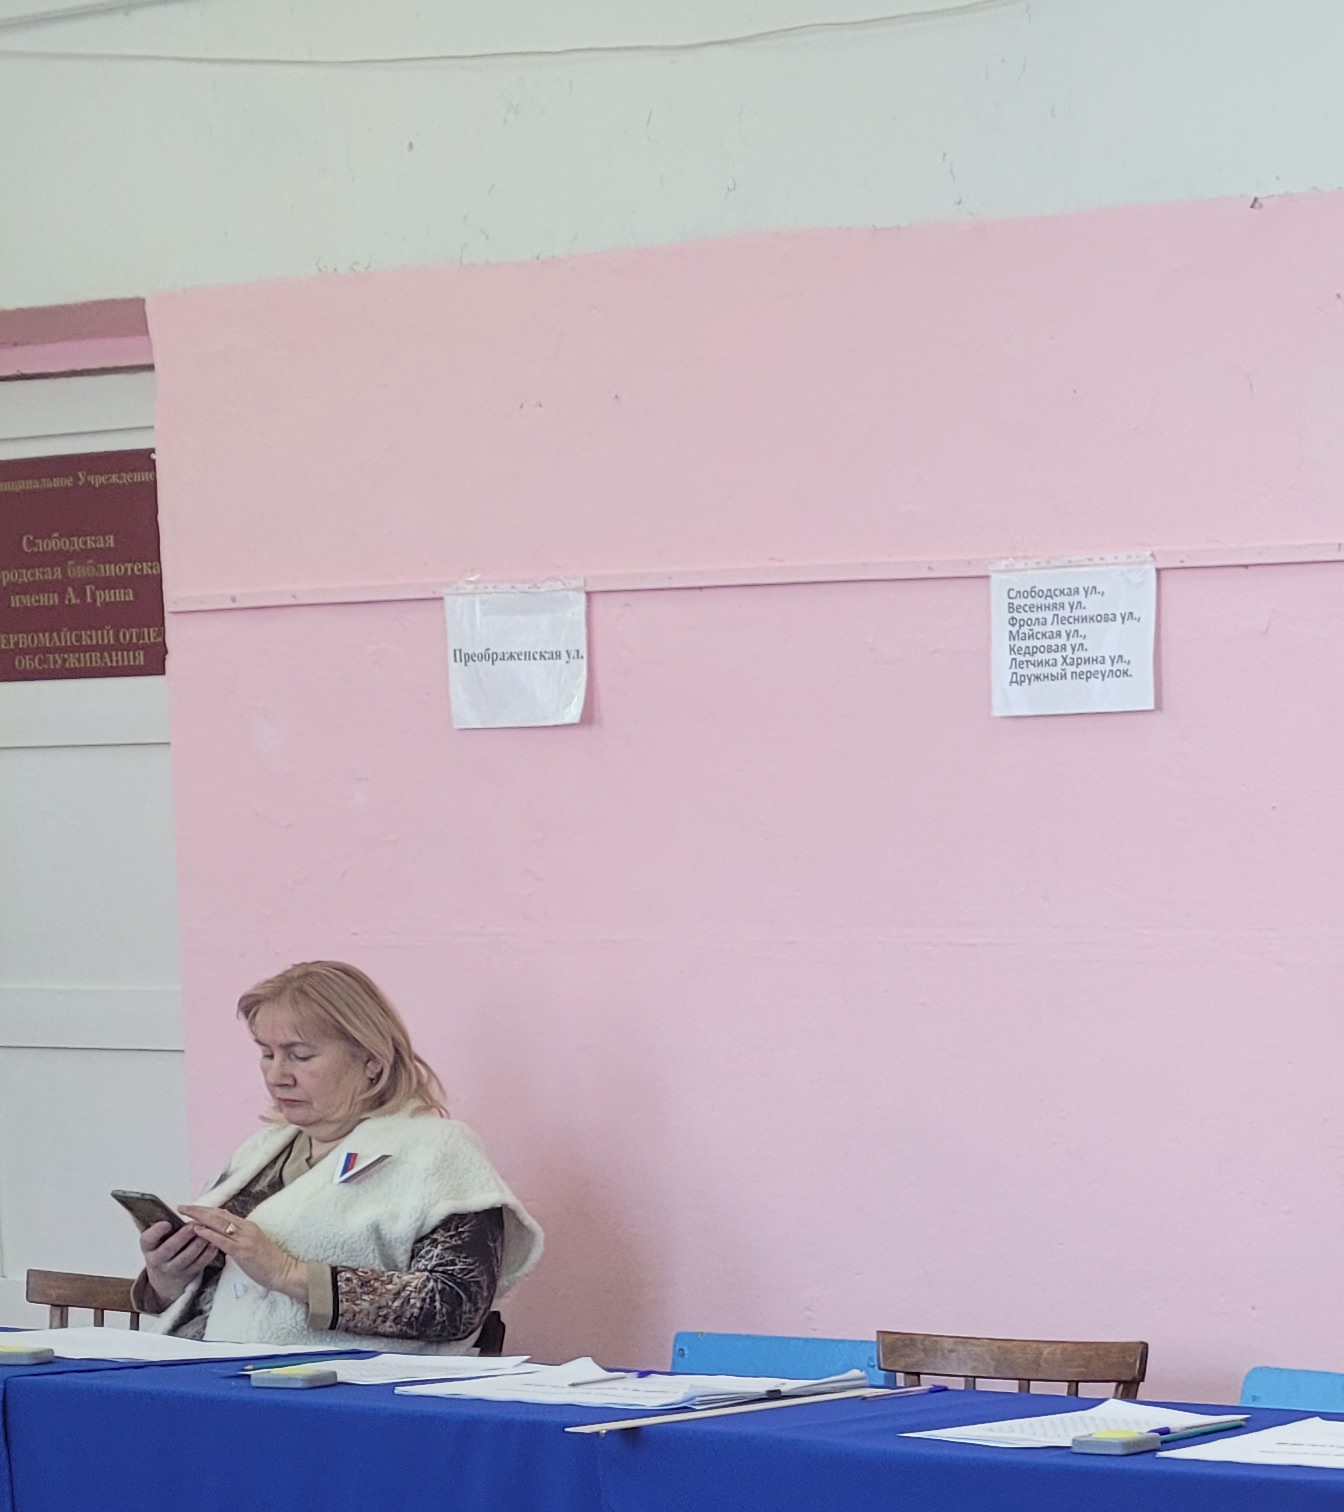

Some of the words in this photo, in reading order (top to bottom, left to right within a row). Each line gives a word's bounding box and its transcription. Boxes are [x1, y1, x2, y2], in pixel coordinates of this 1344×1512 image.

[77, 470, 156, 489] Учреждение
[21, 532, 115, 553] Слободская
[1, 567, 62, 587] родская
[66, 559, 161, 579] библиотека
[10, 592, 59, 609] имени
[65, 586, 80, 605] А.
[84, 584, 135, 607] Грина
[1006, 585, 1080, 601] Слободская
[1082, 584, 1105, 599] ул.,
[1007, 601, 1066, 614] Весенняя
[1067, 600, 1087, 613] ул.
[1007, 614, 1048, 630] Фрола
[1050, 611, 1117, 626] Лесникова
[1119, 610, 1142, 624] ул.,
[1, 625, 115, 649] ЕРВОМАЙСКИЙ
[1008, 628, 1062, 642] Майская
[1064, 628, 1087, 642] ул.,
[453, 648, 562, 667] Преображенская
[565, 649, 584, 664] ул.
[1008, 641, 1067, 657] Кедровая
[1069, 641, 1088, 655] ул.
[14, 649, 146, 671] ОБСЛУЖИВАНИЯ
[1008, 656, 1058, 670] Летчика
[1060, 653, 1106, 668] Харина
[1108, 653, 1131, 667] ул.,
[1009, 668, 1068, 686] Дружный
[1070, 667, 1133, 682] переулок.
